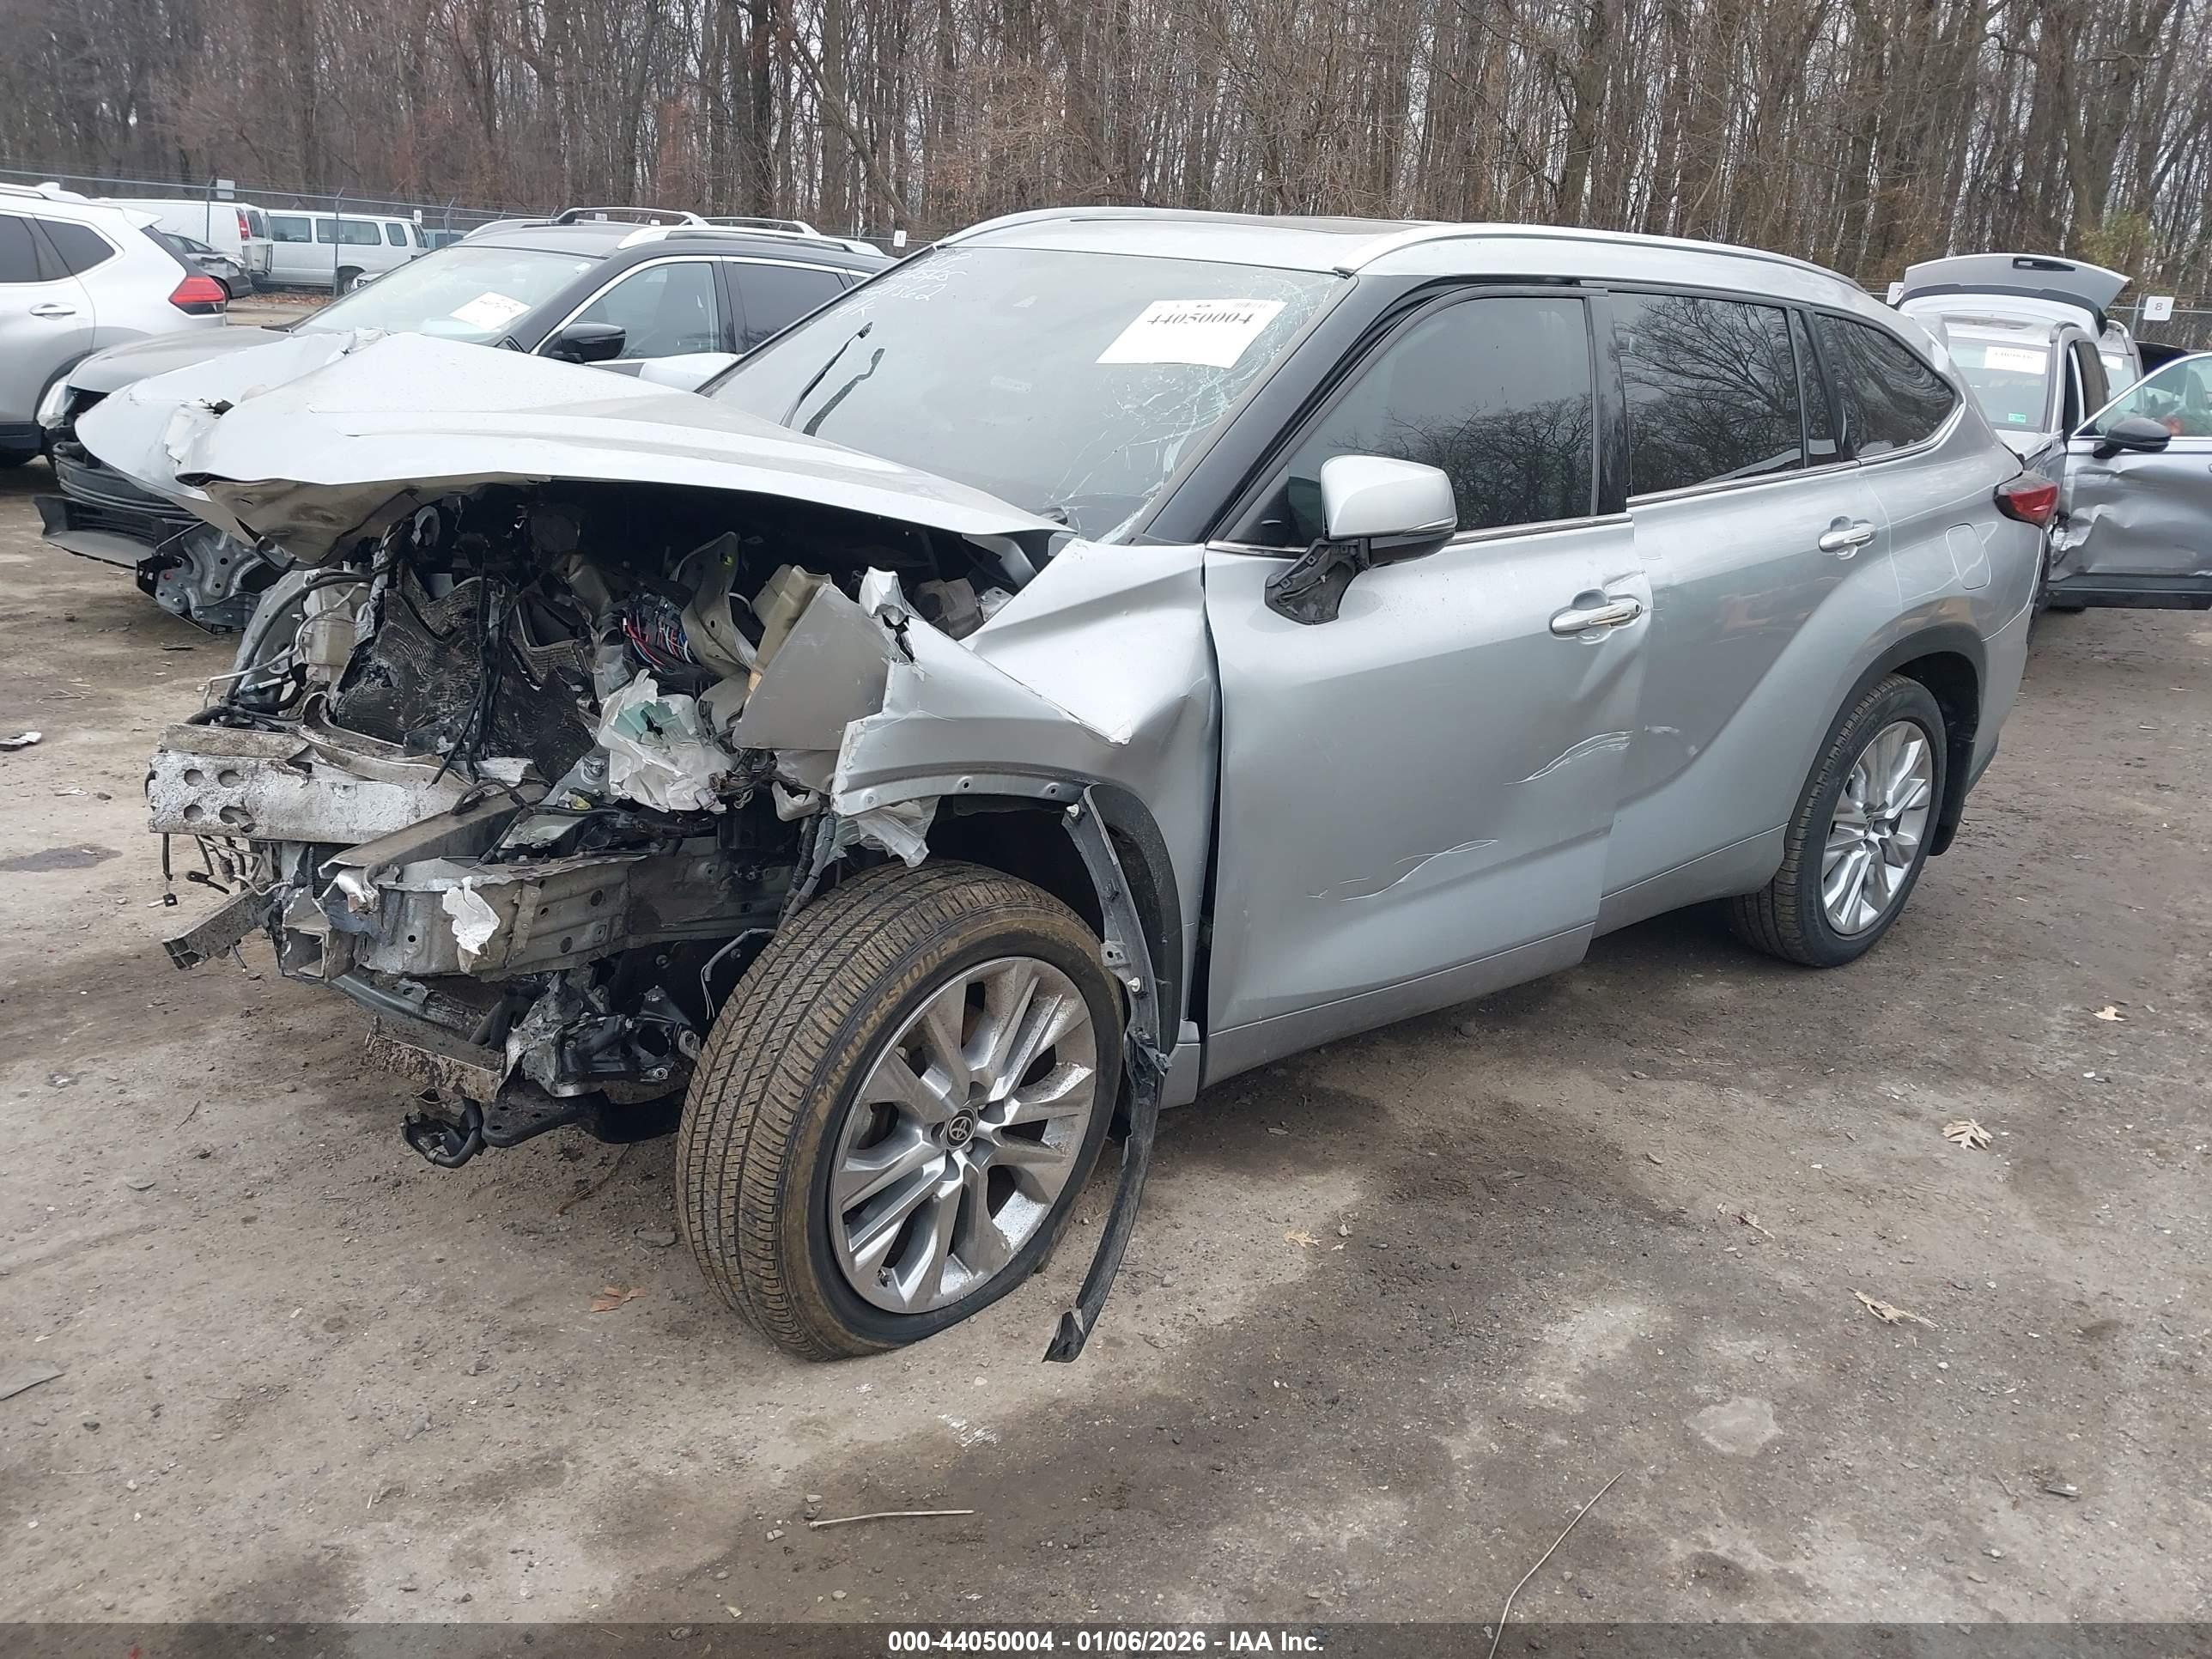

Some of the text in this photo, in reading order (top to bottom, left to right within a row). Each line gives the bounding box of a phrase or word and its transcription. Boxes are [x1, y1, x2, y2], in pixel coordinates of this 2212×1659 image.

[1896, 288, 1904, 296] 7
[2154, 302, 2164, 311] 8
[1146, 312, 1255, 325] 44050004
